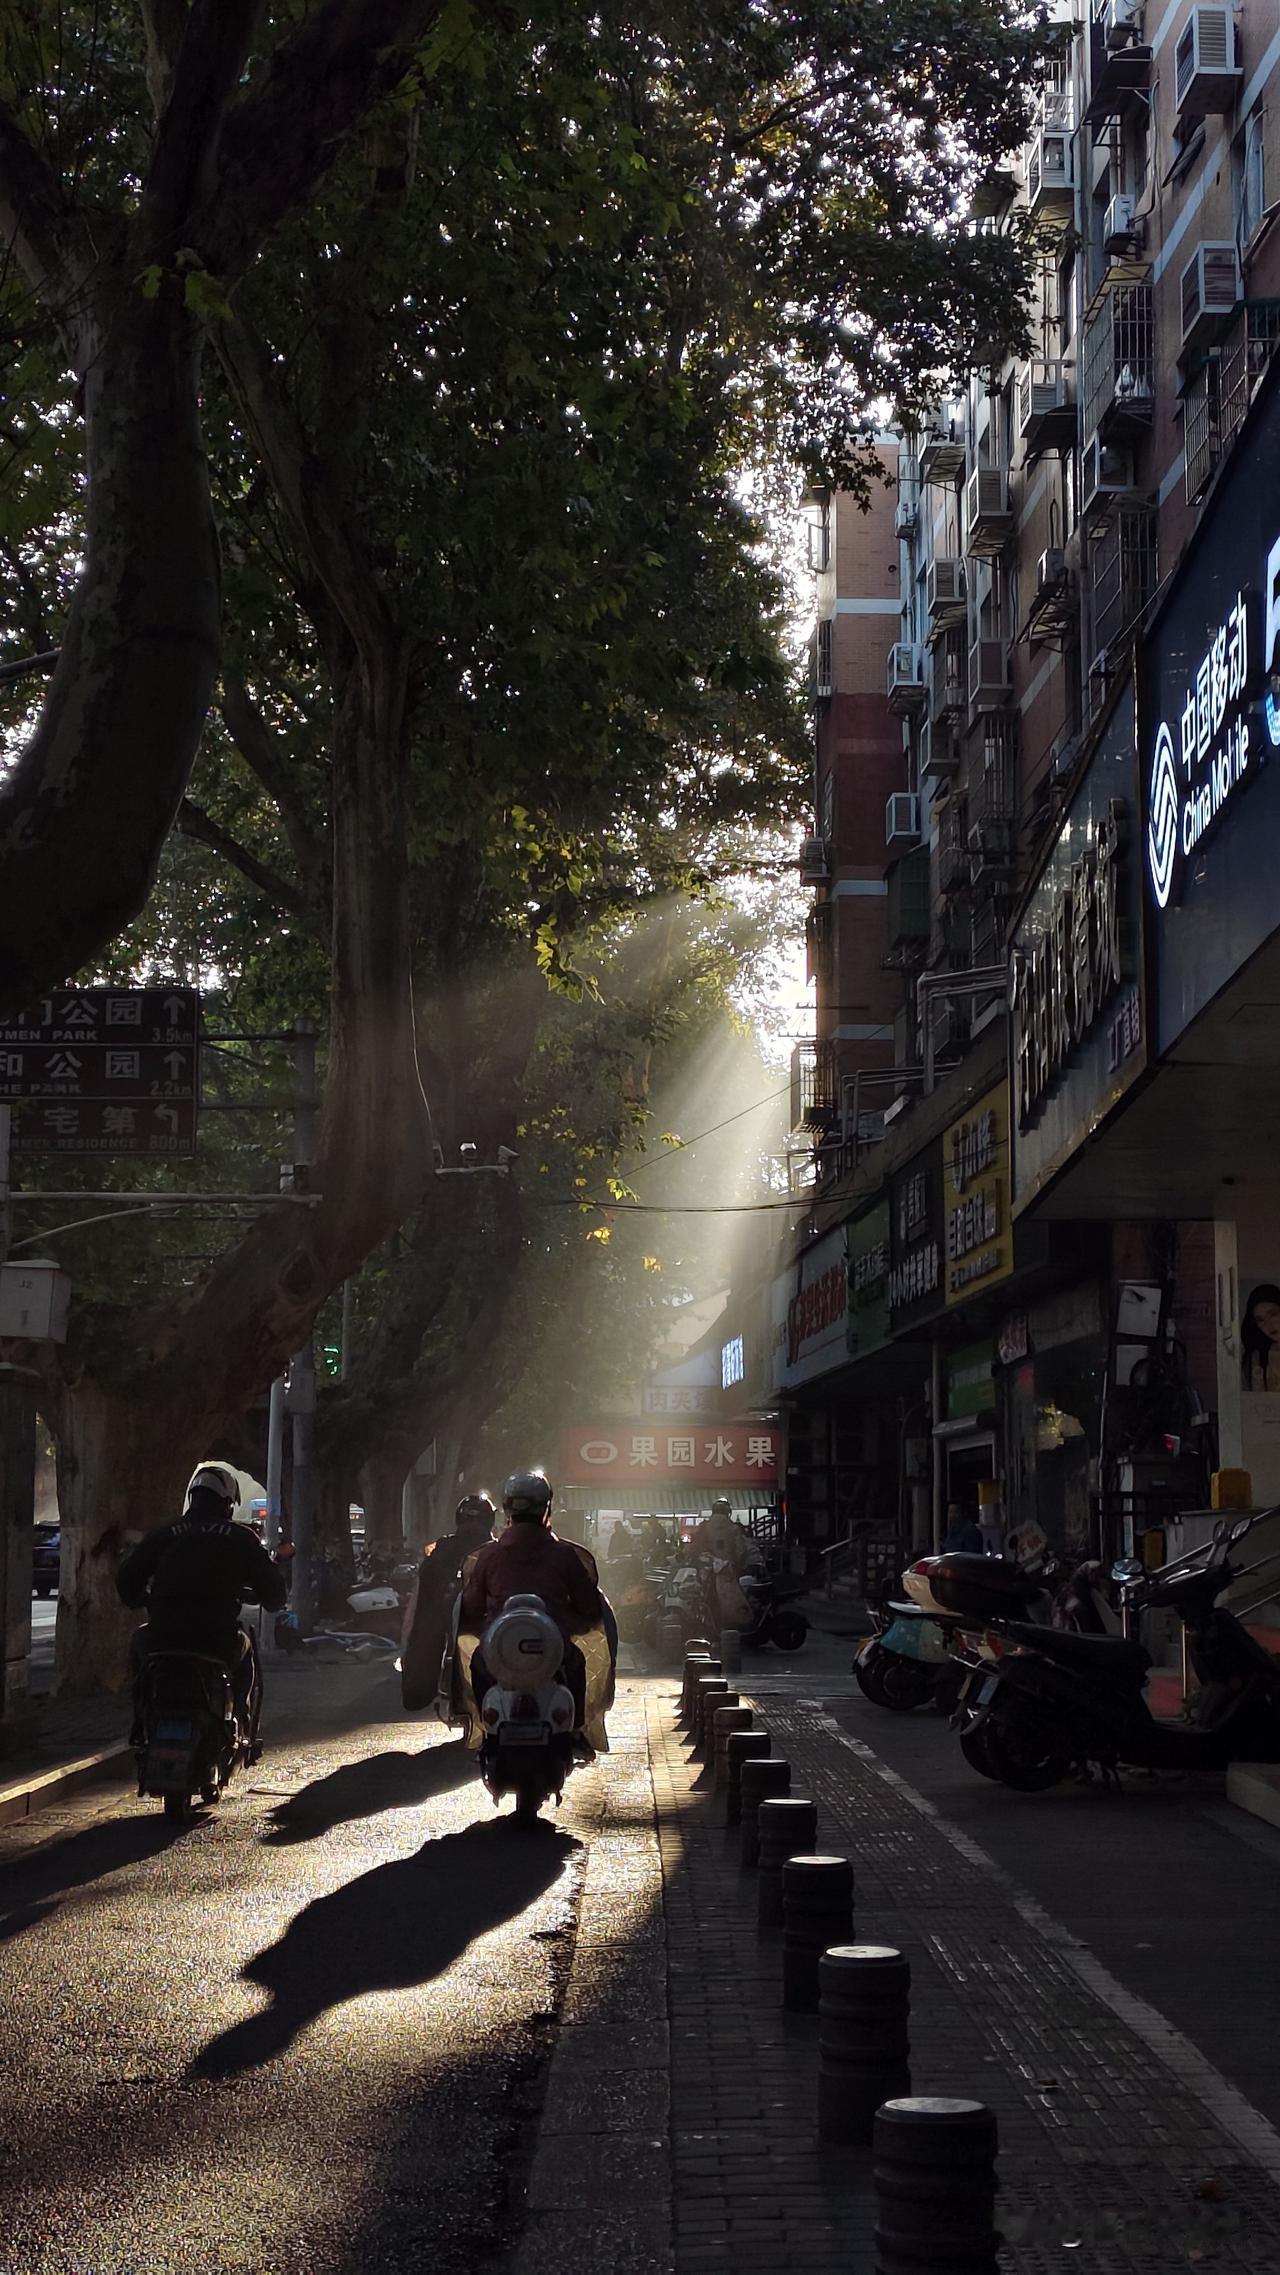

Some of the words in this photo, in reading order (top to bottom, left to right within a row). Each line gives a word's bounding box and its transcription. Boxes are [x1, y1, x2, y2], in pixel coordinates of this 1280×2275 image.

[1181, 590, 1247, 782] 中国移动
[1183, 785, 1211, 856] China
[0, 996, 142, 1026] 门公园
[0, 1029, 41, 1041] MEN
[52, 1029, 97, 1041] PARK
[151, 1026, 192, 1042] 3.5km
[29, 1083, 81, 1094] PARK
[150, 1079, 192, 1096] 2.2km
[58, 1137, 137, 1150] RESIDENCE
[149, 1134, 190, 1150] 800m
[628, 1435, 776, 1468] 果园水果
